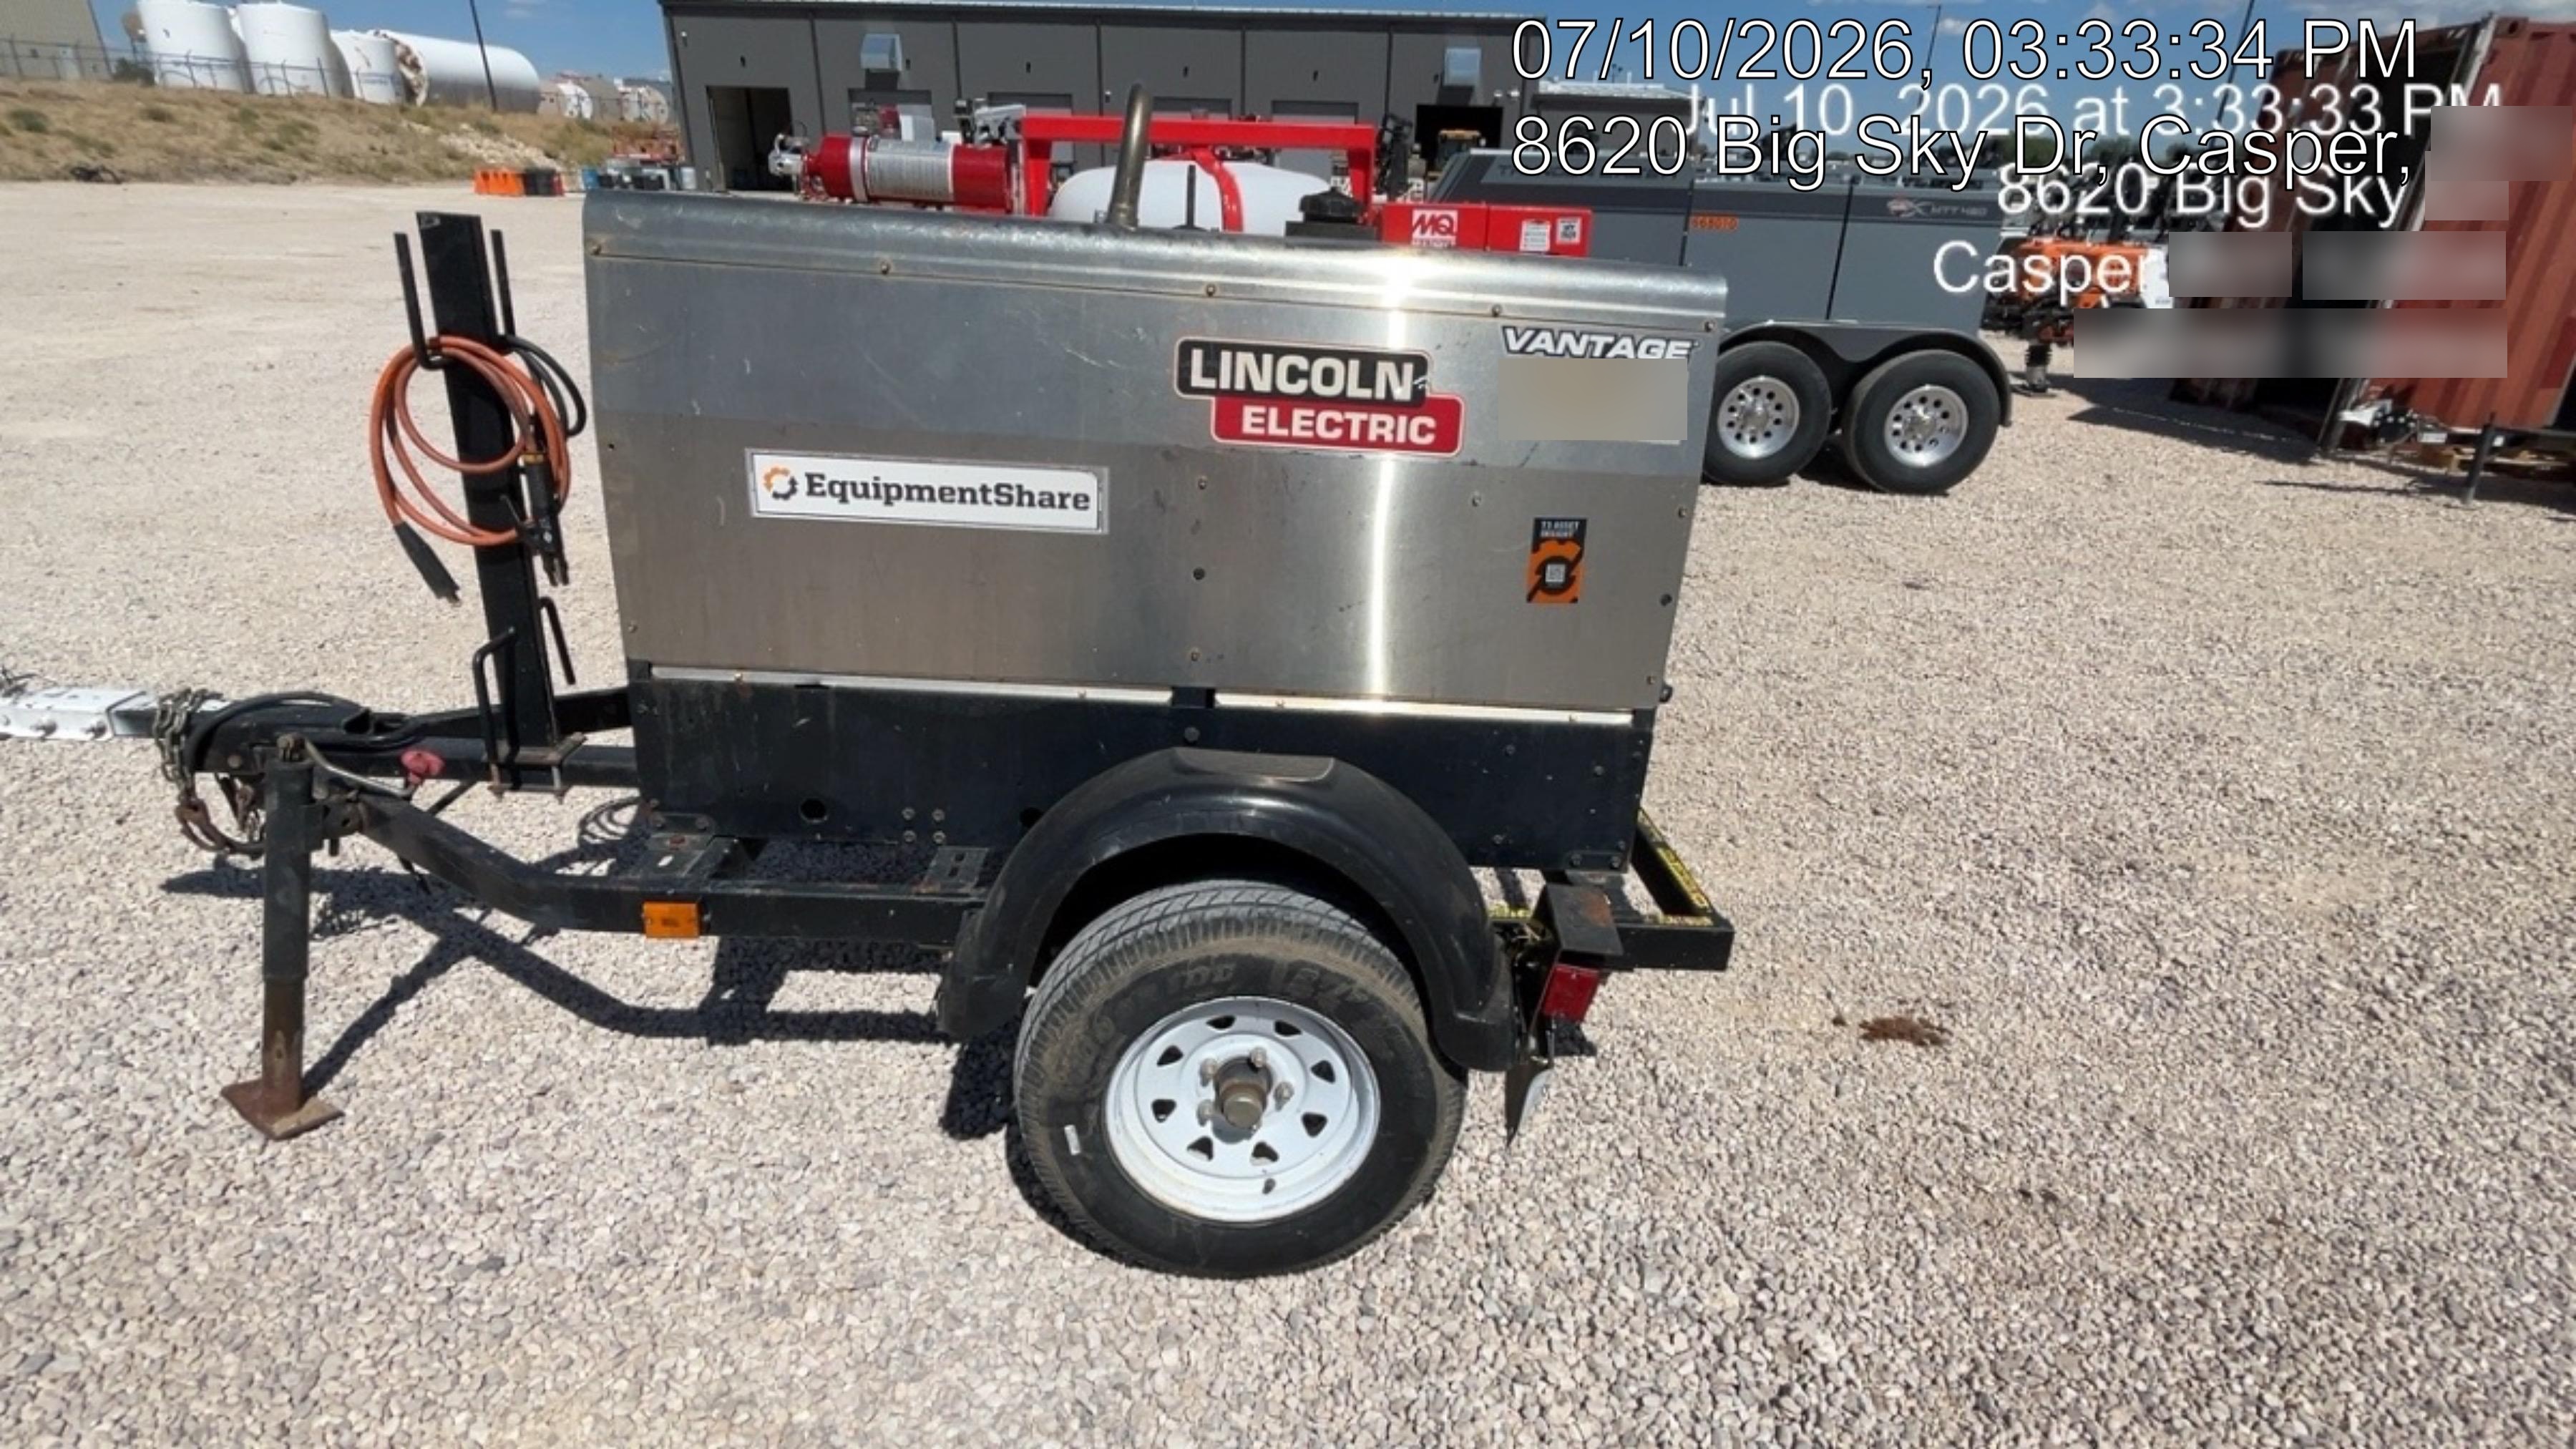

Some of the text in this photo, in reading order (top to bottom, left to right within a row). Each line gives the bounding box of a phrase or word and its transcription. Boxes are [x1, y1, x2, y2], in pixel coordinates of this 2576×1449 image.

[1503, 327, 1694, 358] VANTAGE
[1190, 348, 1414, 403] LINCOLN
[1241, 404, 1436, 445] ELECTRIC
[804, 472, 1091, 511] EquipmentShare
